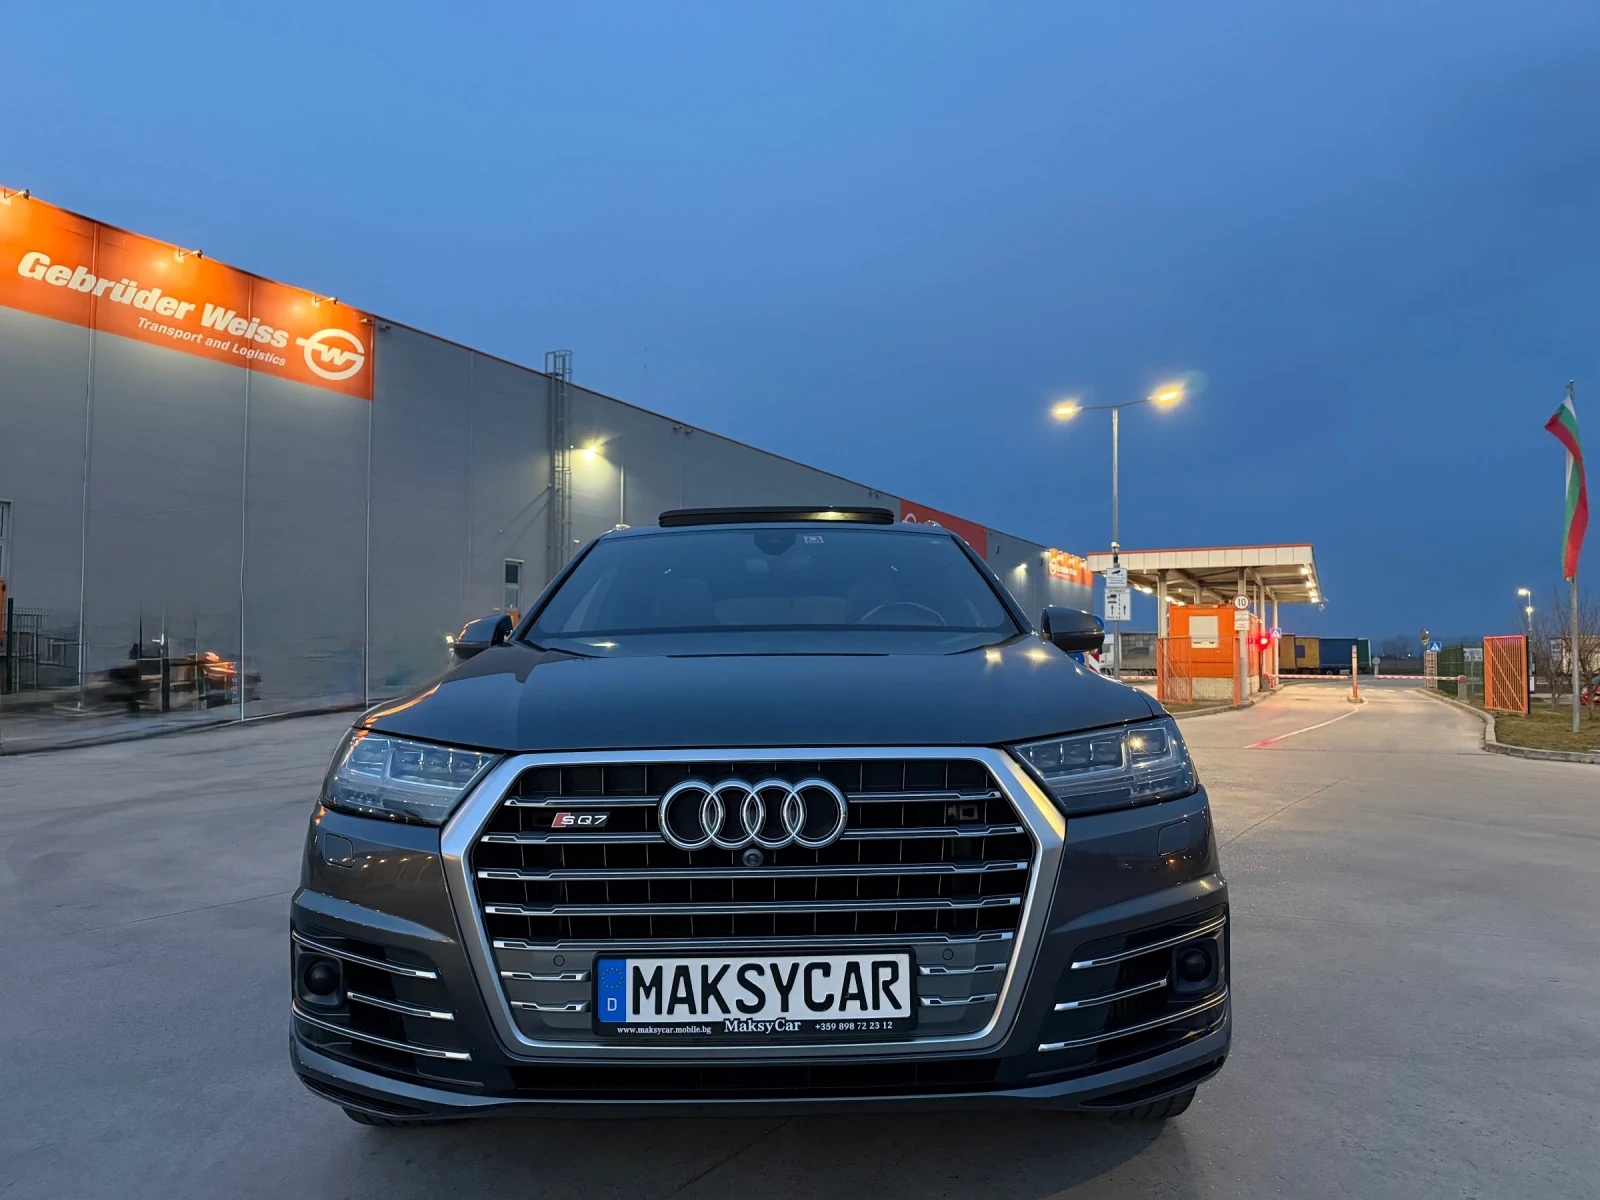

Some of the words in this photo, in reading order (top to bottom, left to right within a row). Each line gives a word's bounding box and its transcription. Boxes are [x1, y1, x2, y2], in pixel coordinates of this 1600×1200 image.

[17, 251, 196, 320] Gebrüder
[200, 302, 290, 348] Weiss
[137, 316, 203, 344] Transport
[204, 337, 231, 351] and
[232, 343, 287, 367] Logistics
[1237, 598, 1247, 607] 10
[561, 815, 607, 825] SQ7
[632, 960, 902, 1015] MAKSYCAR
[607, 997, 617, 1012] D
[617, 1026, 712, 1035] www.maksycar.mobile.bg
[723, 1018, 802, 1034] MaksyCar
[814, 1022, 837, 1031] +359
[838, 1022, 855, 1031] 898
[856, 1022, 867, 1030] 72
[869, 1021, 880, 1030] 23
[882, 1021, 893, 1030] 12
